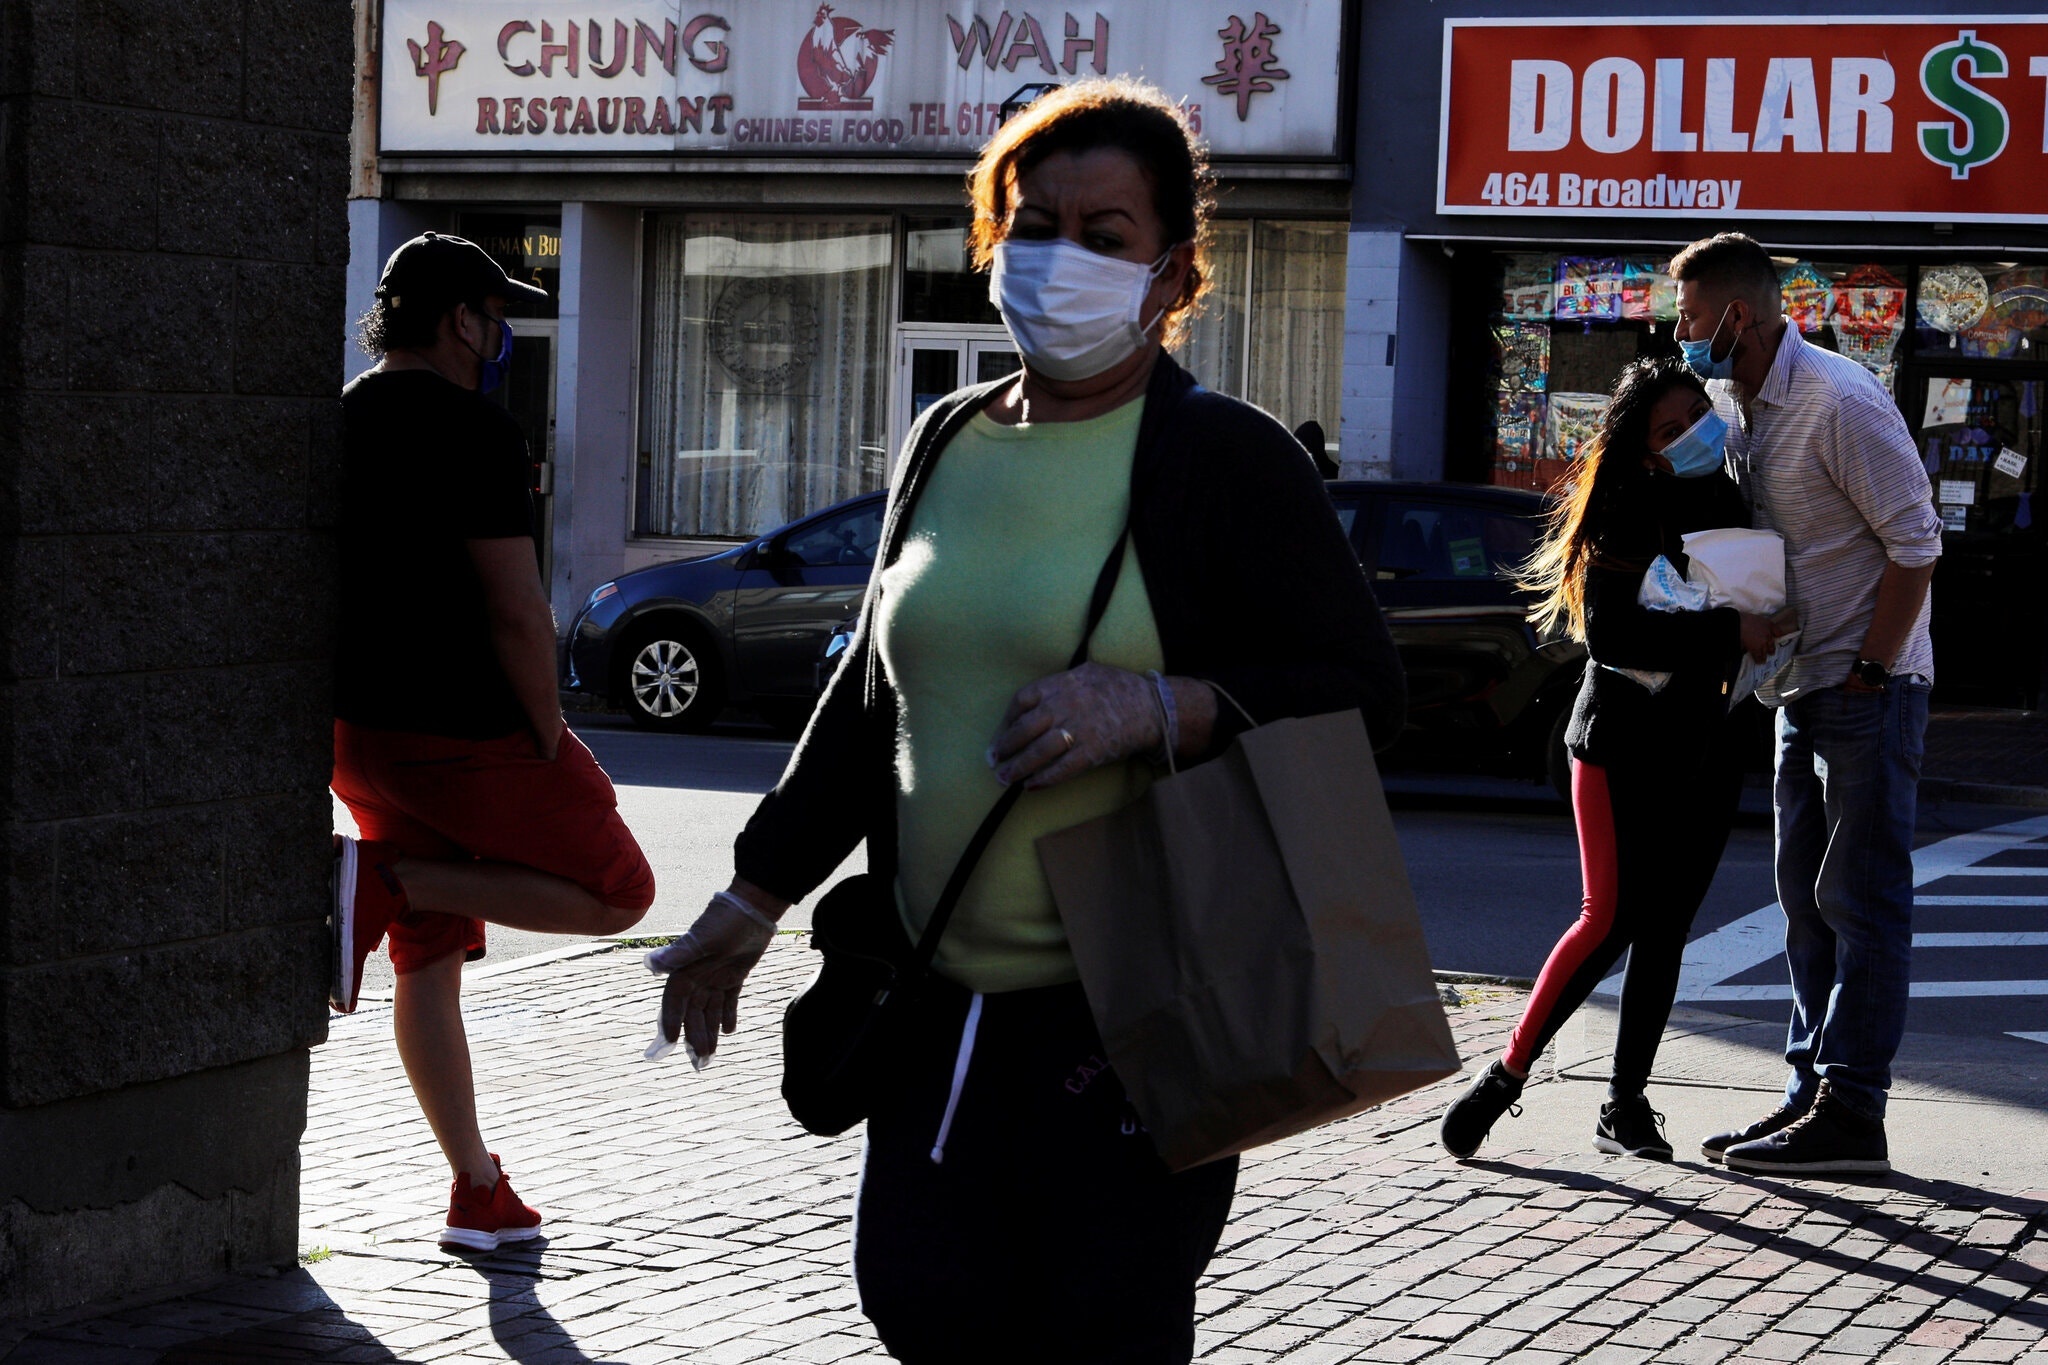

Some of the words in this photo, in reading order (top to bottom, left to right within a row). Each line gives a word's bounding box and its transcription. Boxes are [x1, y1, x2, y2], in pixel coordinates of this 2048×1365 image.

[497, 13, 732, 79] CHUNG
[945, 10, 1109, 76] WAH
[406, 19, 468, 117] 中
[1201, 11, 1291, 122] 華
[475, 94, 734, 136] RESTAURANT
[909, 103, 950, 136] TEL
[1507, 56, 1896, 153] DOLLAR
[733, 118, 832, 144] CHINESE
[842, 117, 903, 144] FOOD
[1481, 172, 1550, 207] 464
[1559, 173, 1741, 210] Broadway
[1948, 445, 1995, 463] DAY
